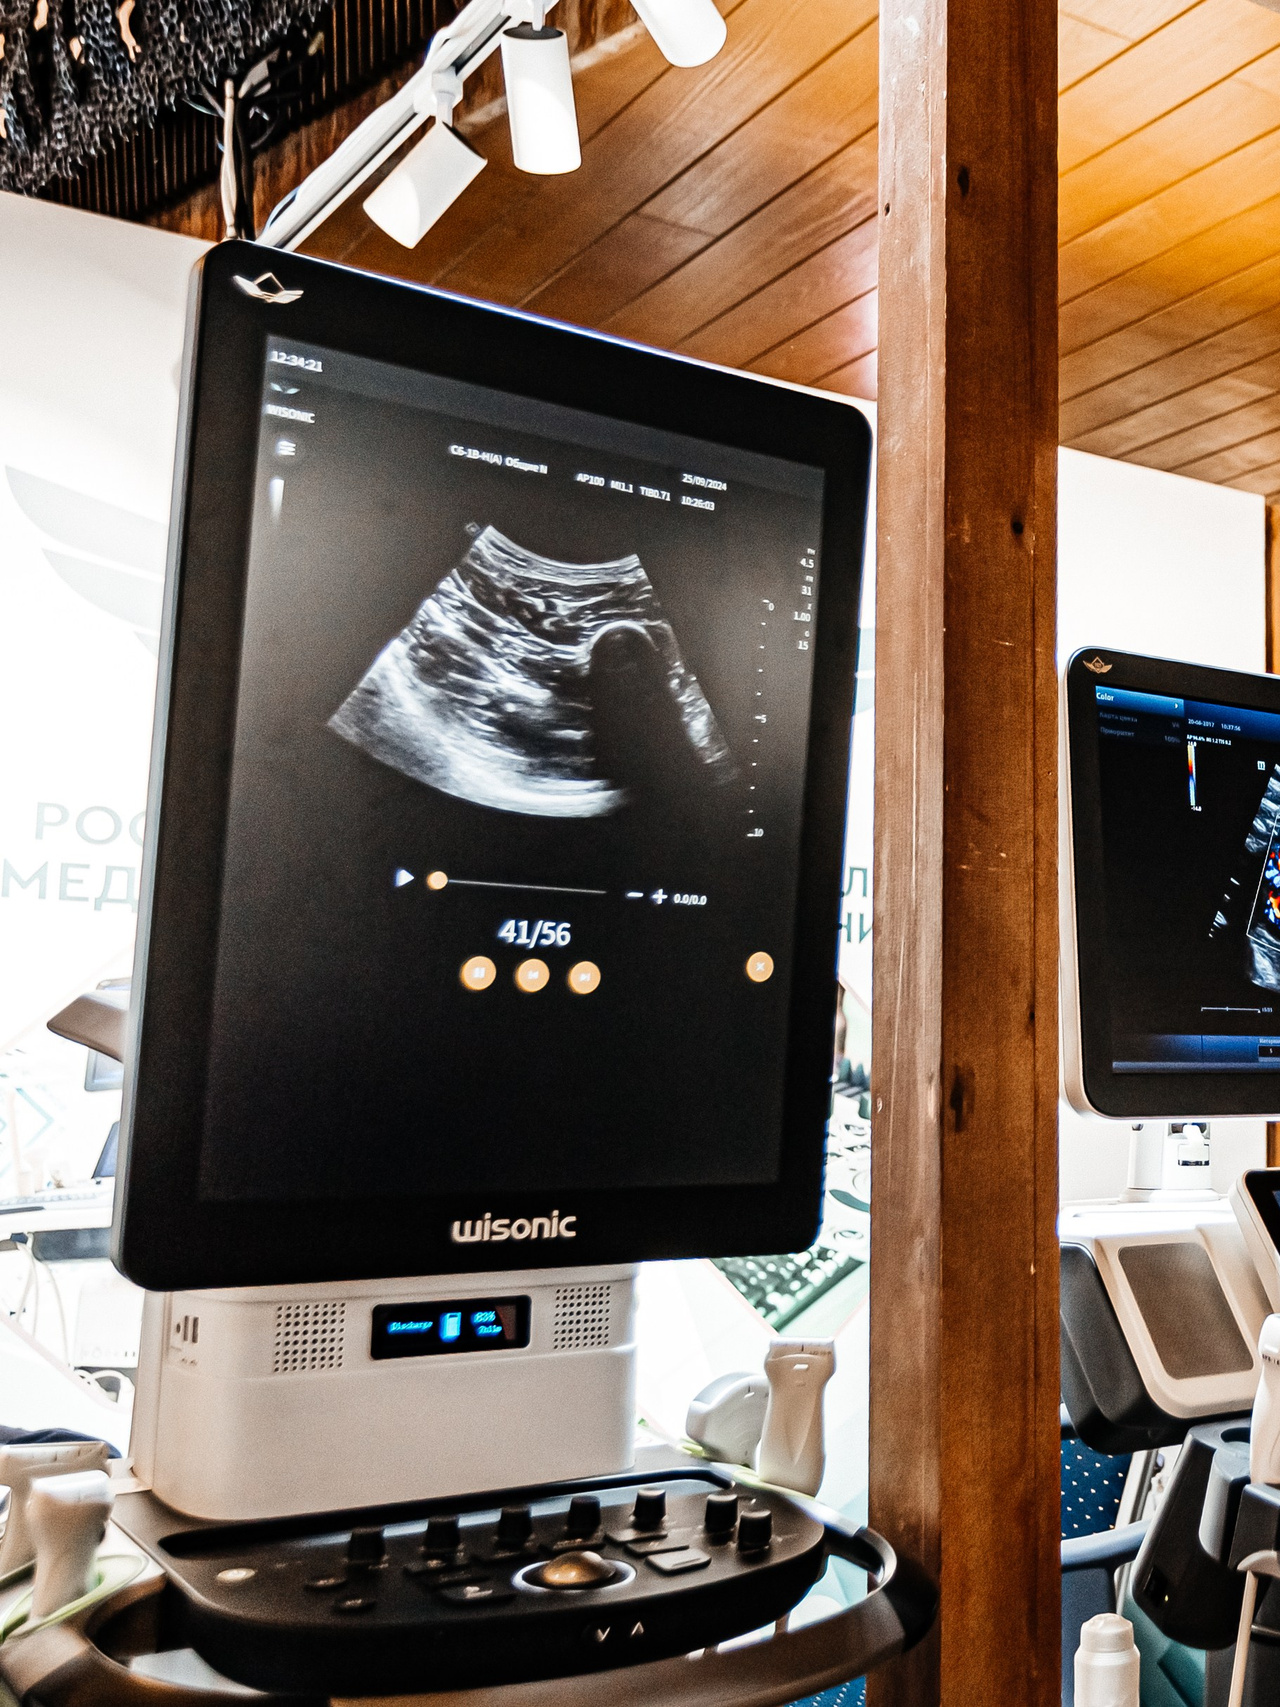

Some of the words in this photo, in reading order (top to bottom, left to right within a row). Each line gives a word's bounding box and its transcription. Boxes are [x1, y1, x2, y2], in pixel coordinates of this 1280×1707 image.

[270, 350, 323, 373] 12:34:21
[801, 585, 812, 597] 31
[797, 640, 809, 651] 15
[1095, 692, 1115, 702] Color
[498, 919, 571, 948] 41/56
[452, 1209, 577, 1243] wisonic
